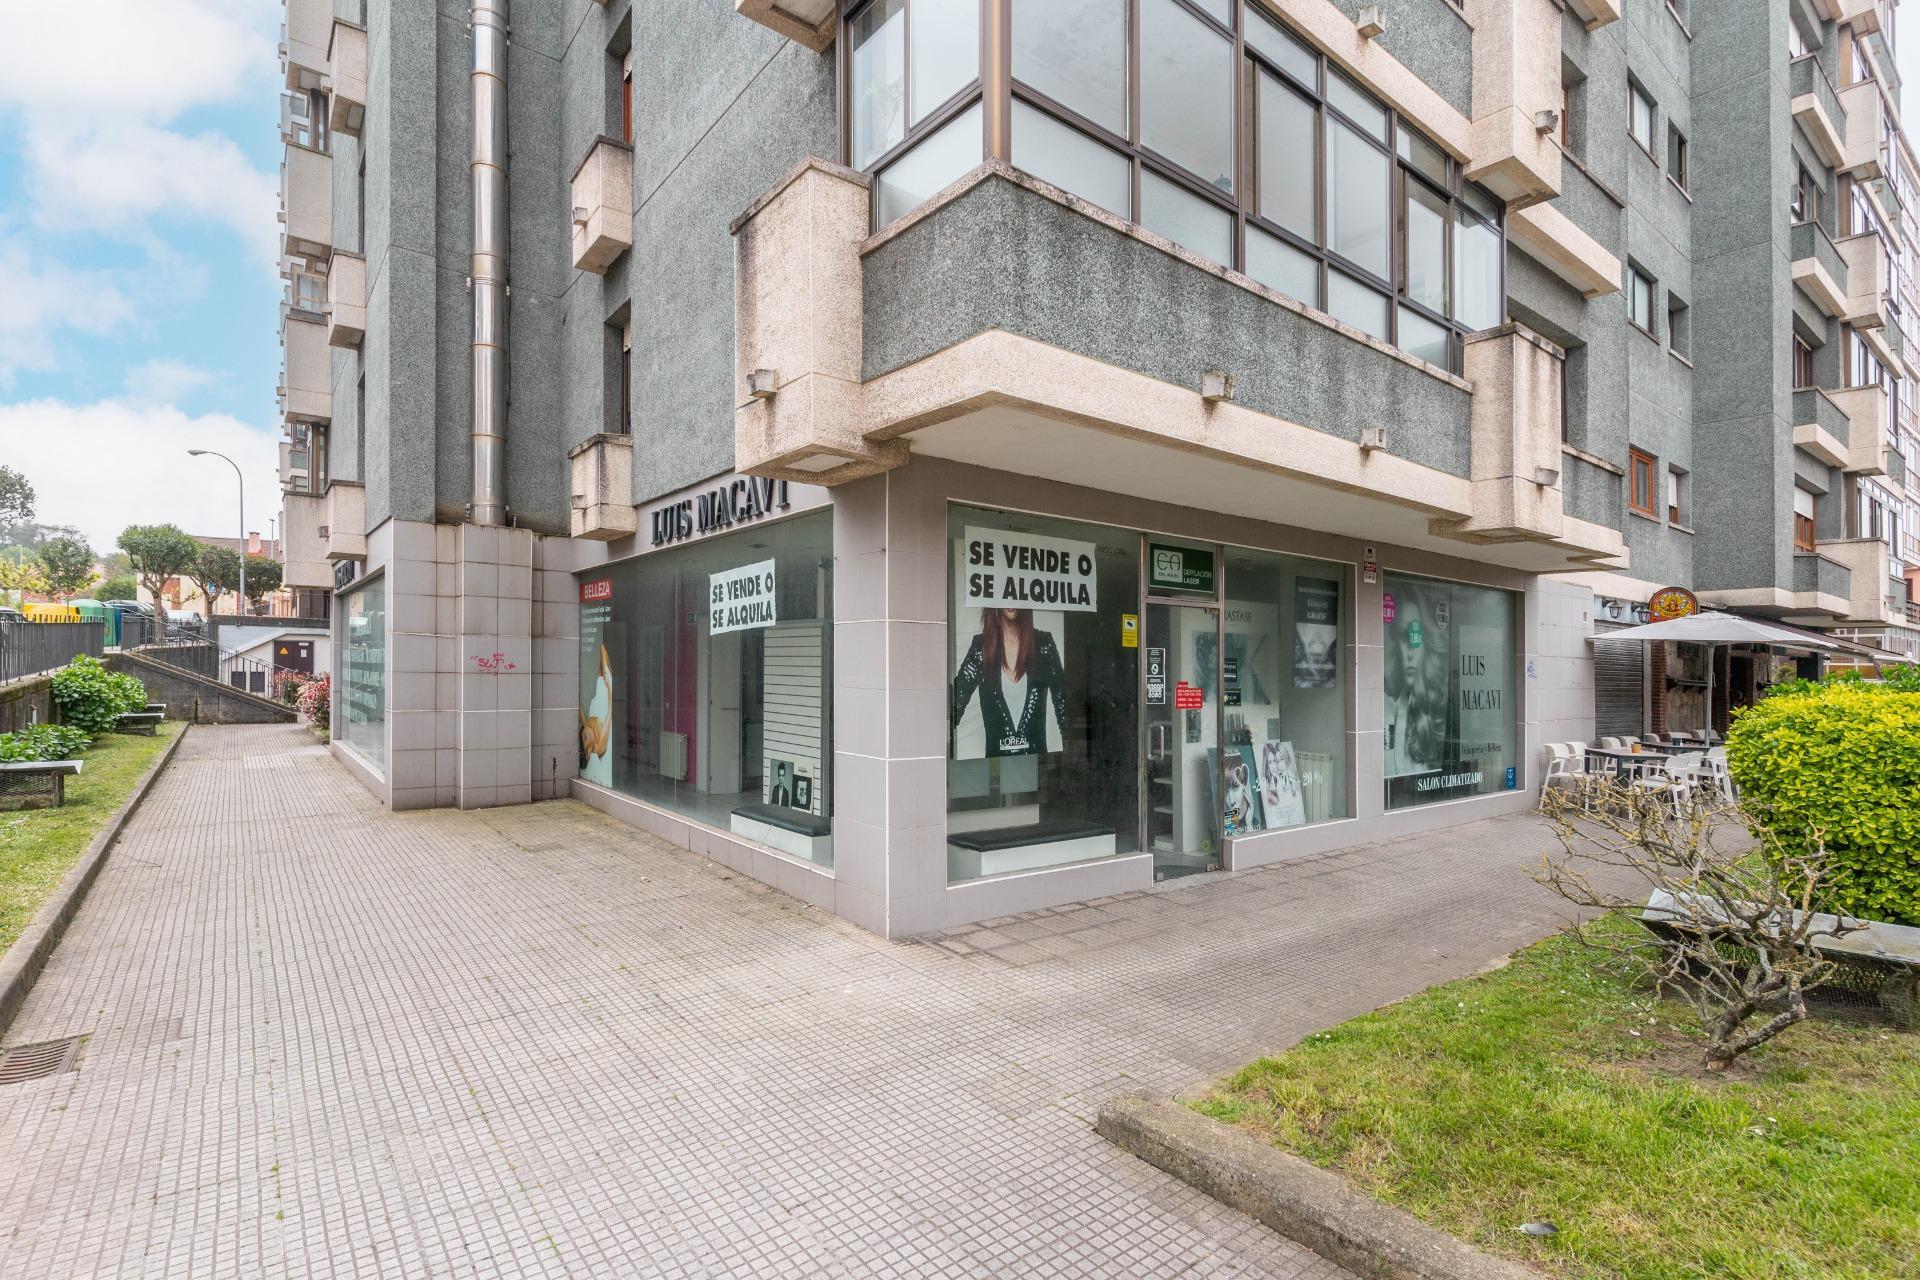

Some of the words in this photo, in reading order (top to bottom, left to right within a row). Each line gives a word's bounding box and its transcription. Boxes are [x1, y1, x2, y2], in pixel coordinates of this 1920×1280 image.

[651, 499, 693, 545] LUIS
[696, 474, 791, 534] MACAVI
[968, 540, 995, 567] SE
[1002, 544, 1070, 575] VENDE
[1077, 553, 1093, 577] O
[584, 581, 610, 599] BELLEZA
[712, 583, 724, 604] SE
[726, 574, 762, 601] VENDE
[765, 572, 774, 593] O
[968, 573, 995, 598] SE
[1002, 576, 1091, 606] ALQUILA
[712, 609, 724, 629] SE
[726, 600, 773, 626] ALQUILA
[1462, 655, 1485, 676] LUIS
[1462, 689, 1502, 711] MACAVI
[1440, 771, 1483, 789] CLIMATIZADO
